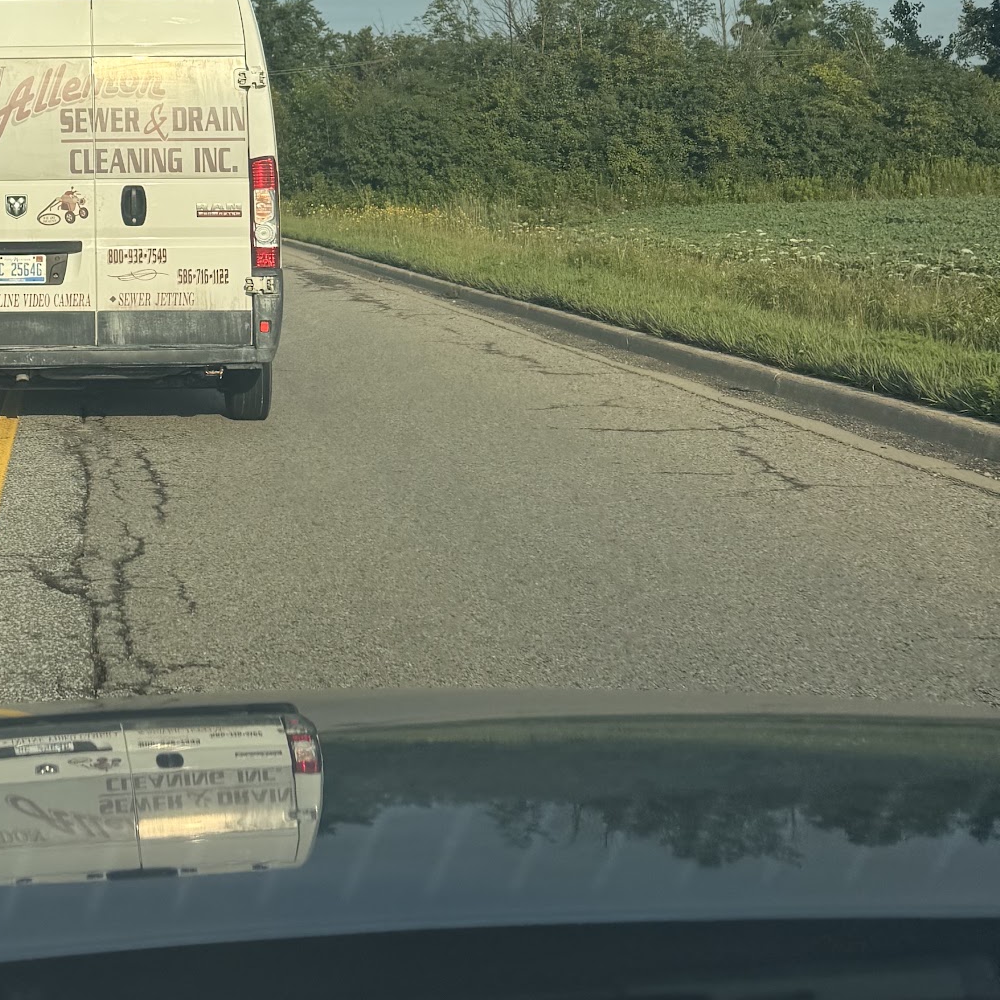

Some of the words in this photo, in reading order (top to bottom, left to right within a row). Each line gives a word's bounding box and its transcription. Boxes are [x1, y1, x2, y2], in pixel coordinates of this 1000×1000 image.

[60, 107, 140, 133] SEWER
[143, 102, 169, 142] &
[172, 106, 246, 132] DRAIN
[69, 148, 183, 174] CLEANING
[194, 147, 238, 173] INC.
[23, 293, 51, 307] VIDEO
[53, 293, 91, 307] CAMERA
[118, 292, 151, 306] SEWER
[155, 292, 195, 306] JETTING
